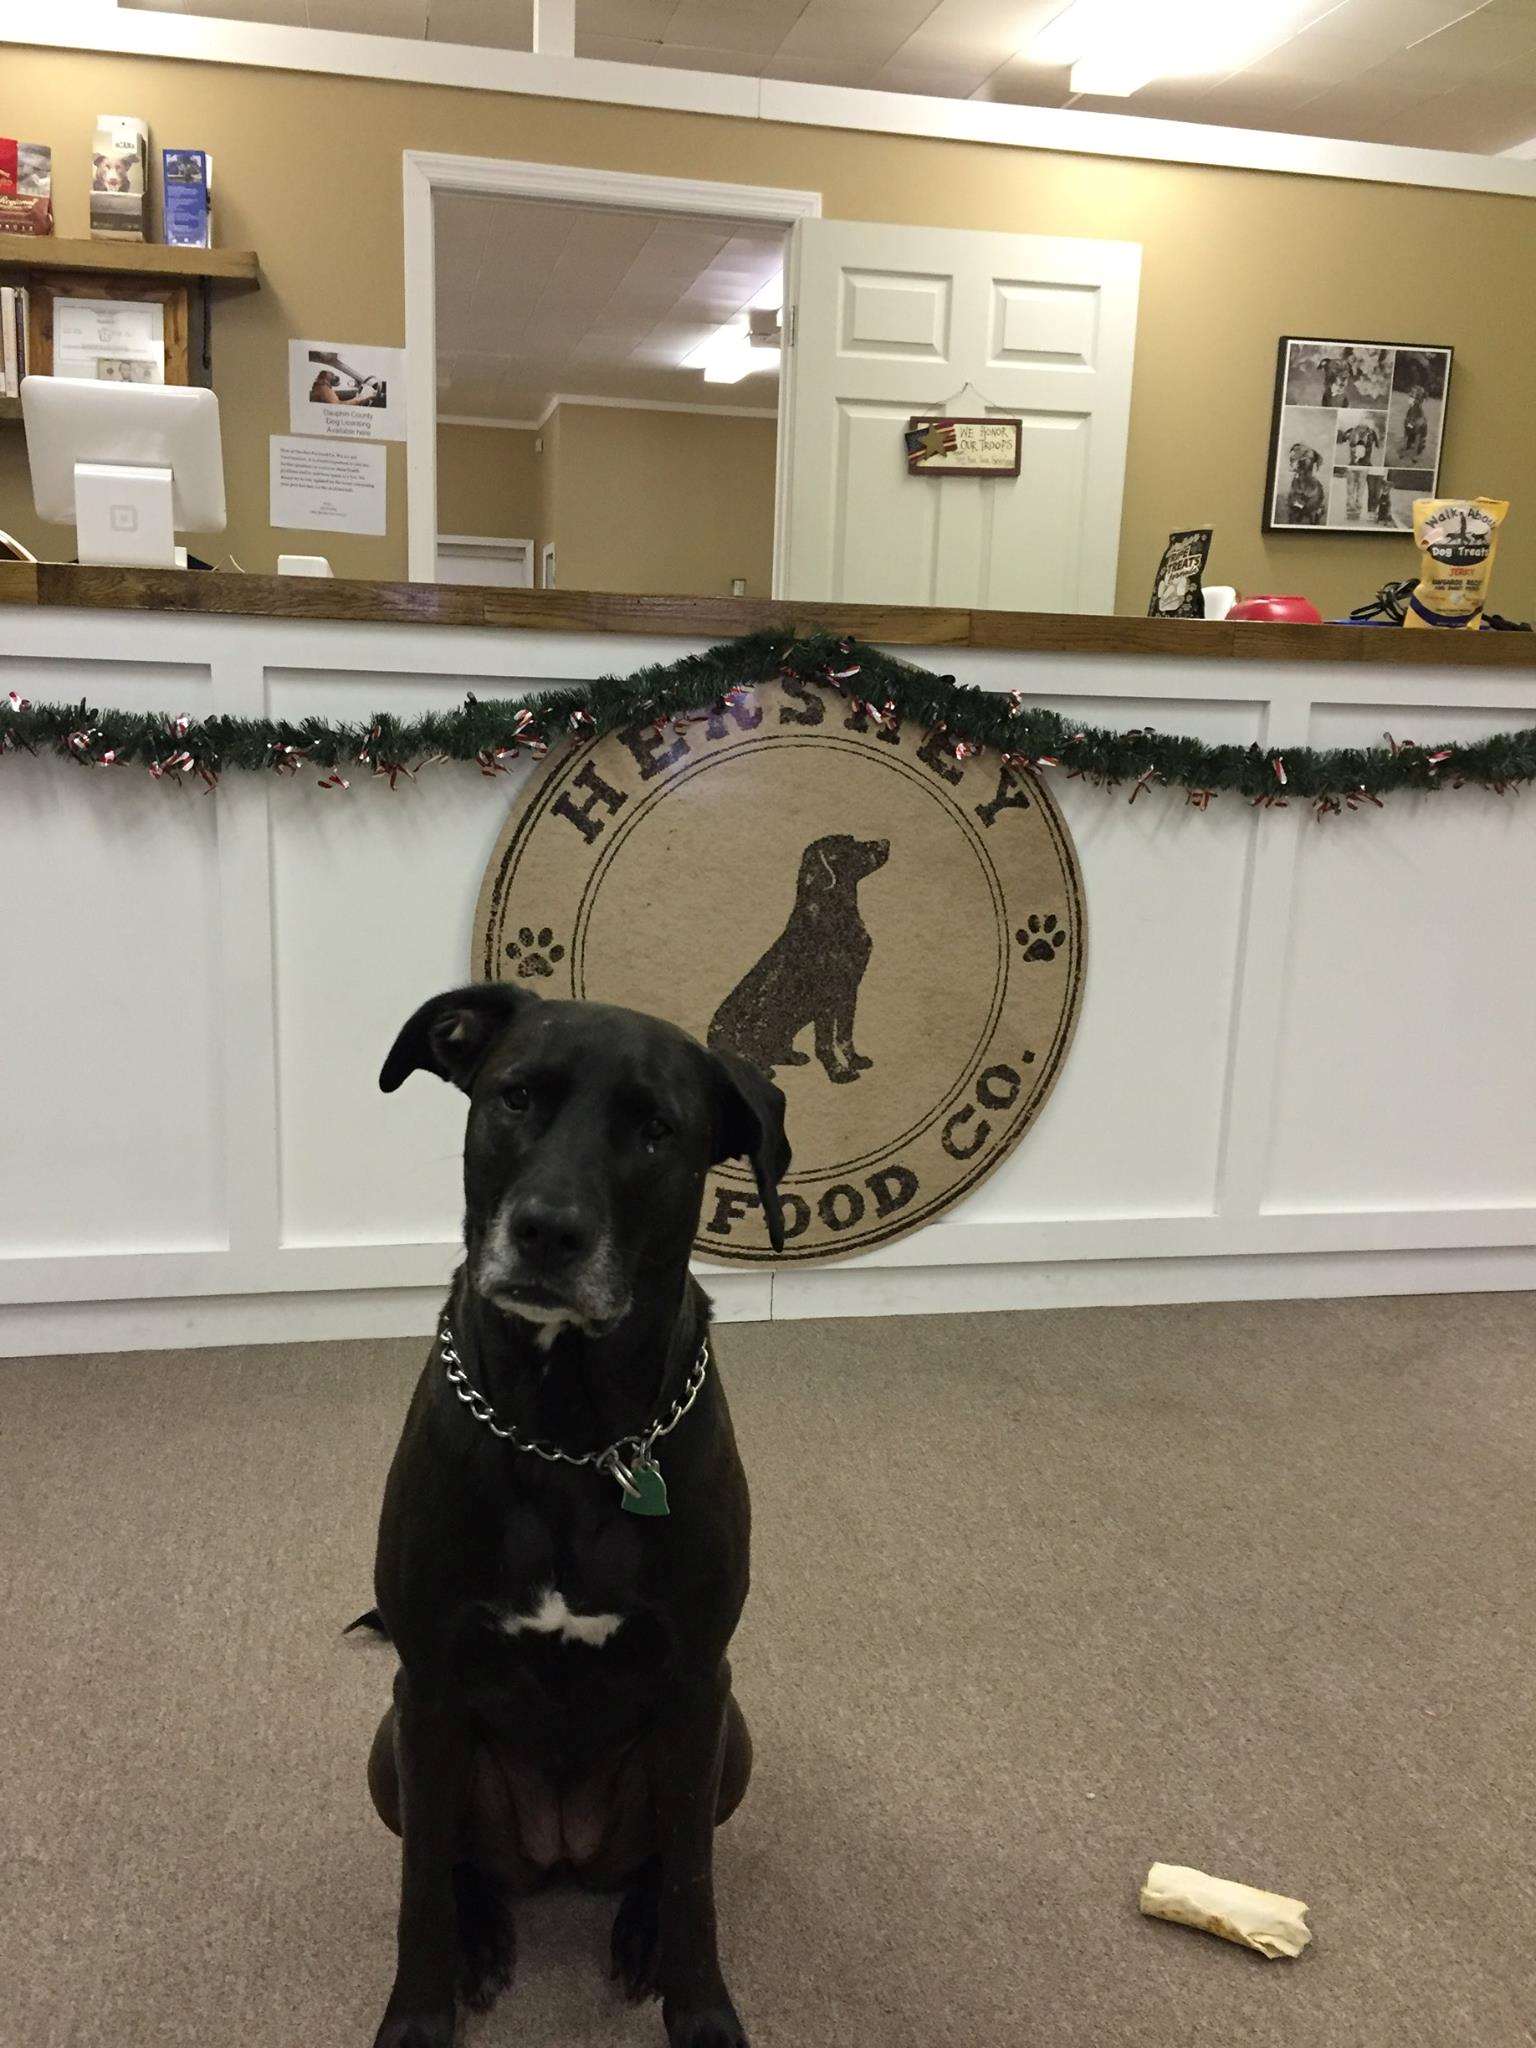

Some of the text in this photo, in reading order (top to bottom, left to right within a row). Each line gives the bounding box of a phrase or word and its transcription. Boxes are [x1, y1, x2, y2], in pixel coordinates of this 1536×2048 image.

[326, 417, 340, 427] Dog
[351, 411, 373, 420] County
[960, 426, 1009, 440] WE HONOR
[960, 439, 1013, 452] OUR TROOPS
[1425, 508, 1459, 529] Walk
[1431, 546, 1490, 558] Dog Treats
[941, 1050, 1035, 1160] CO.
